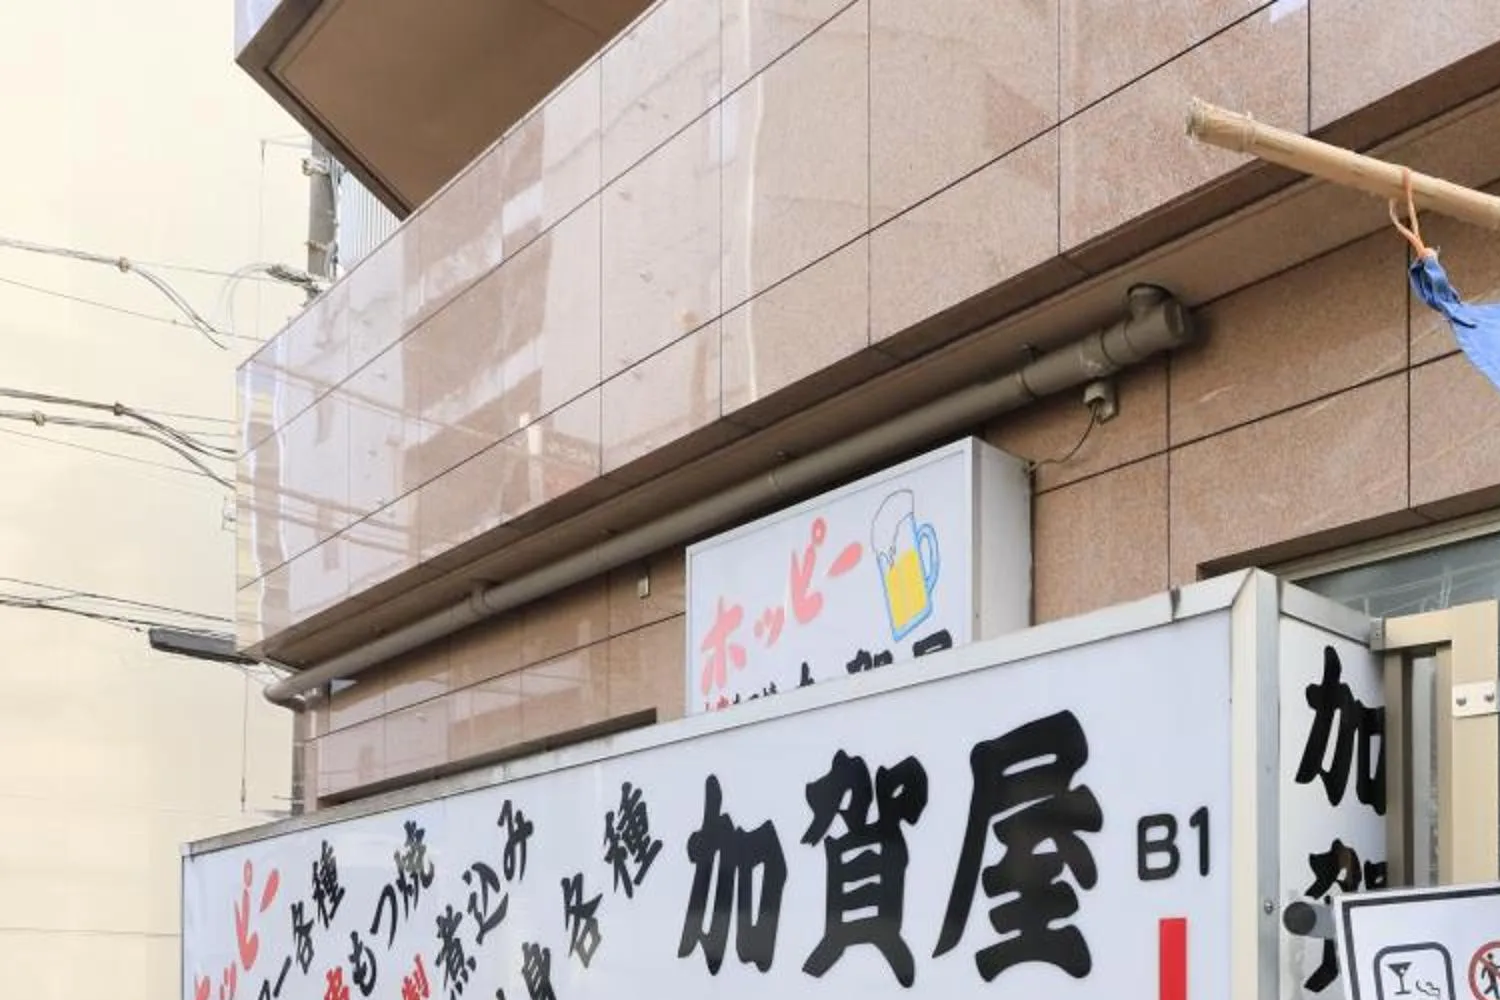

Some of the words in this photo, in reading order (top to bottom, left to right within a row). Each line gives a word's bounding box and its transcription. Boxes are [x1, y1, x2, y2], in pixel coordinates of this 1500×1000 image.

[701, 517, 863, 695] ホッピー
[676, 709, 1105, 990] 加賀屋
[1136, 806, 1211, 883] B1
